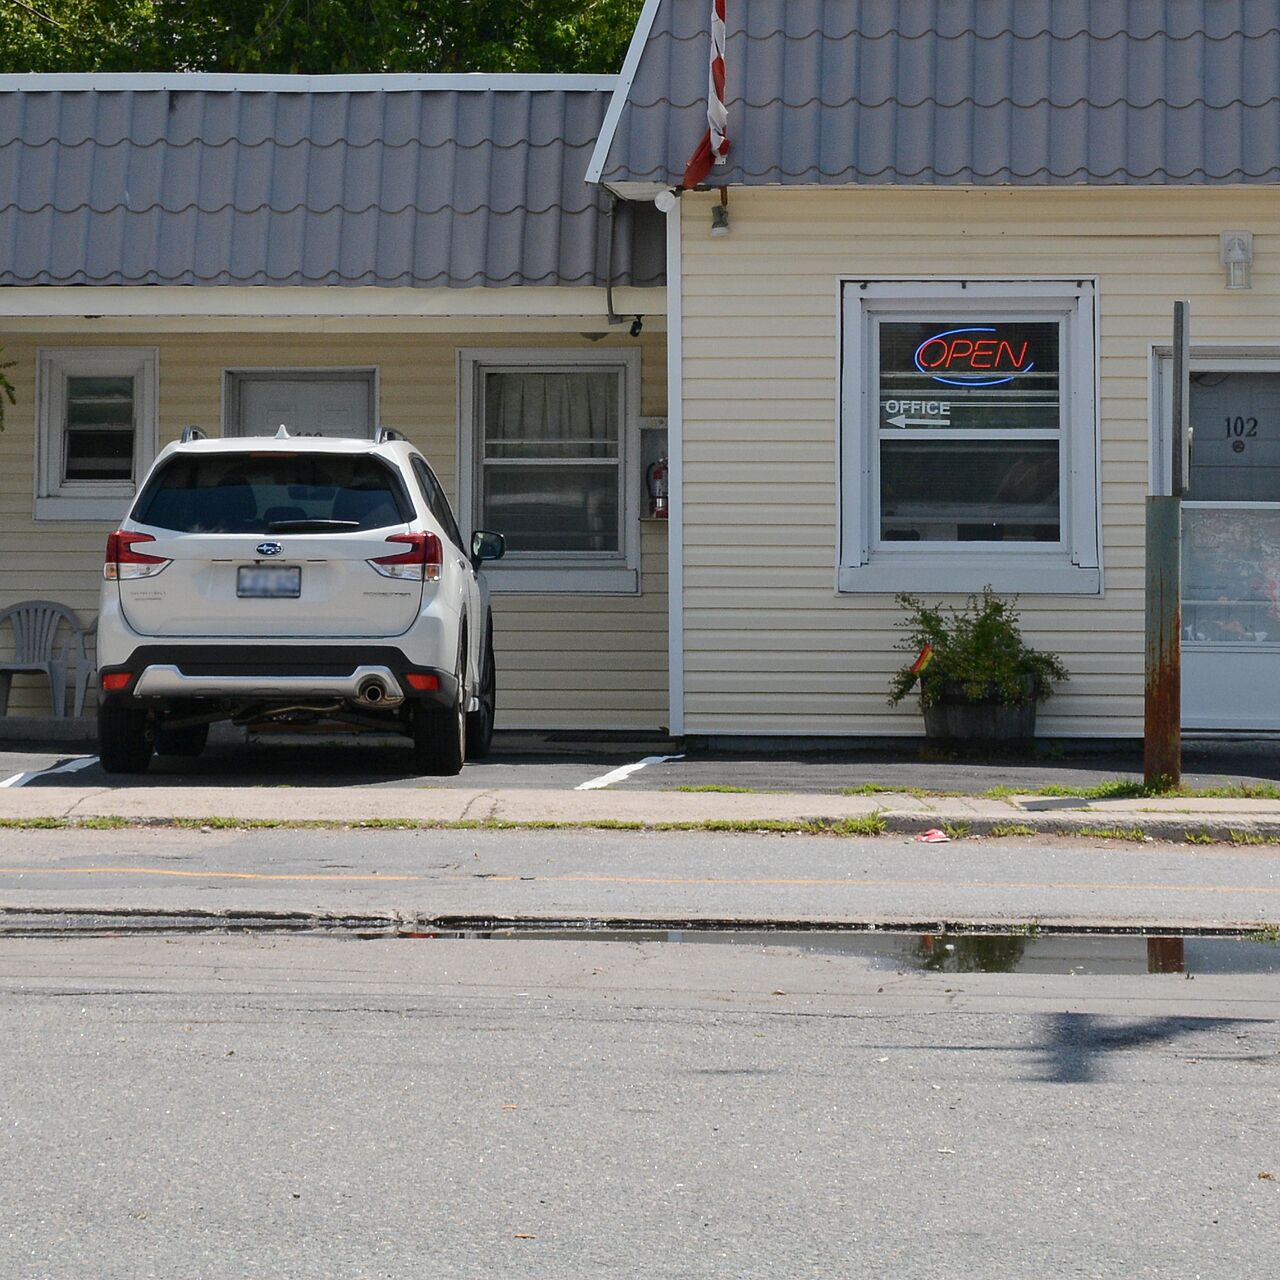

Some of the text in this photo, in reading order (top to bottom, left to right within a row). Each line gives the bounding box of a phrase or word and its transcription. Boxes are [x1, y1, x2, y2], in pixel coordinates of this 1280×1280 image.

[920, 338, 1028, 369] OPEN
[885, 400, 951, 415] OFFICE
[1225, 415, 1258, 438] 102
